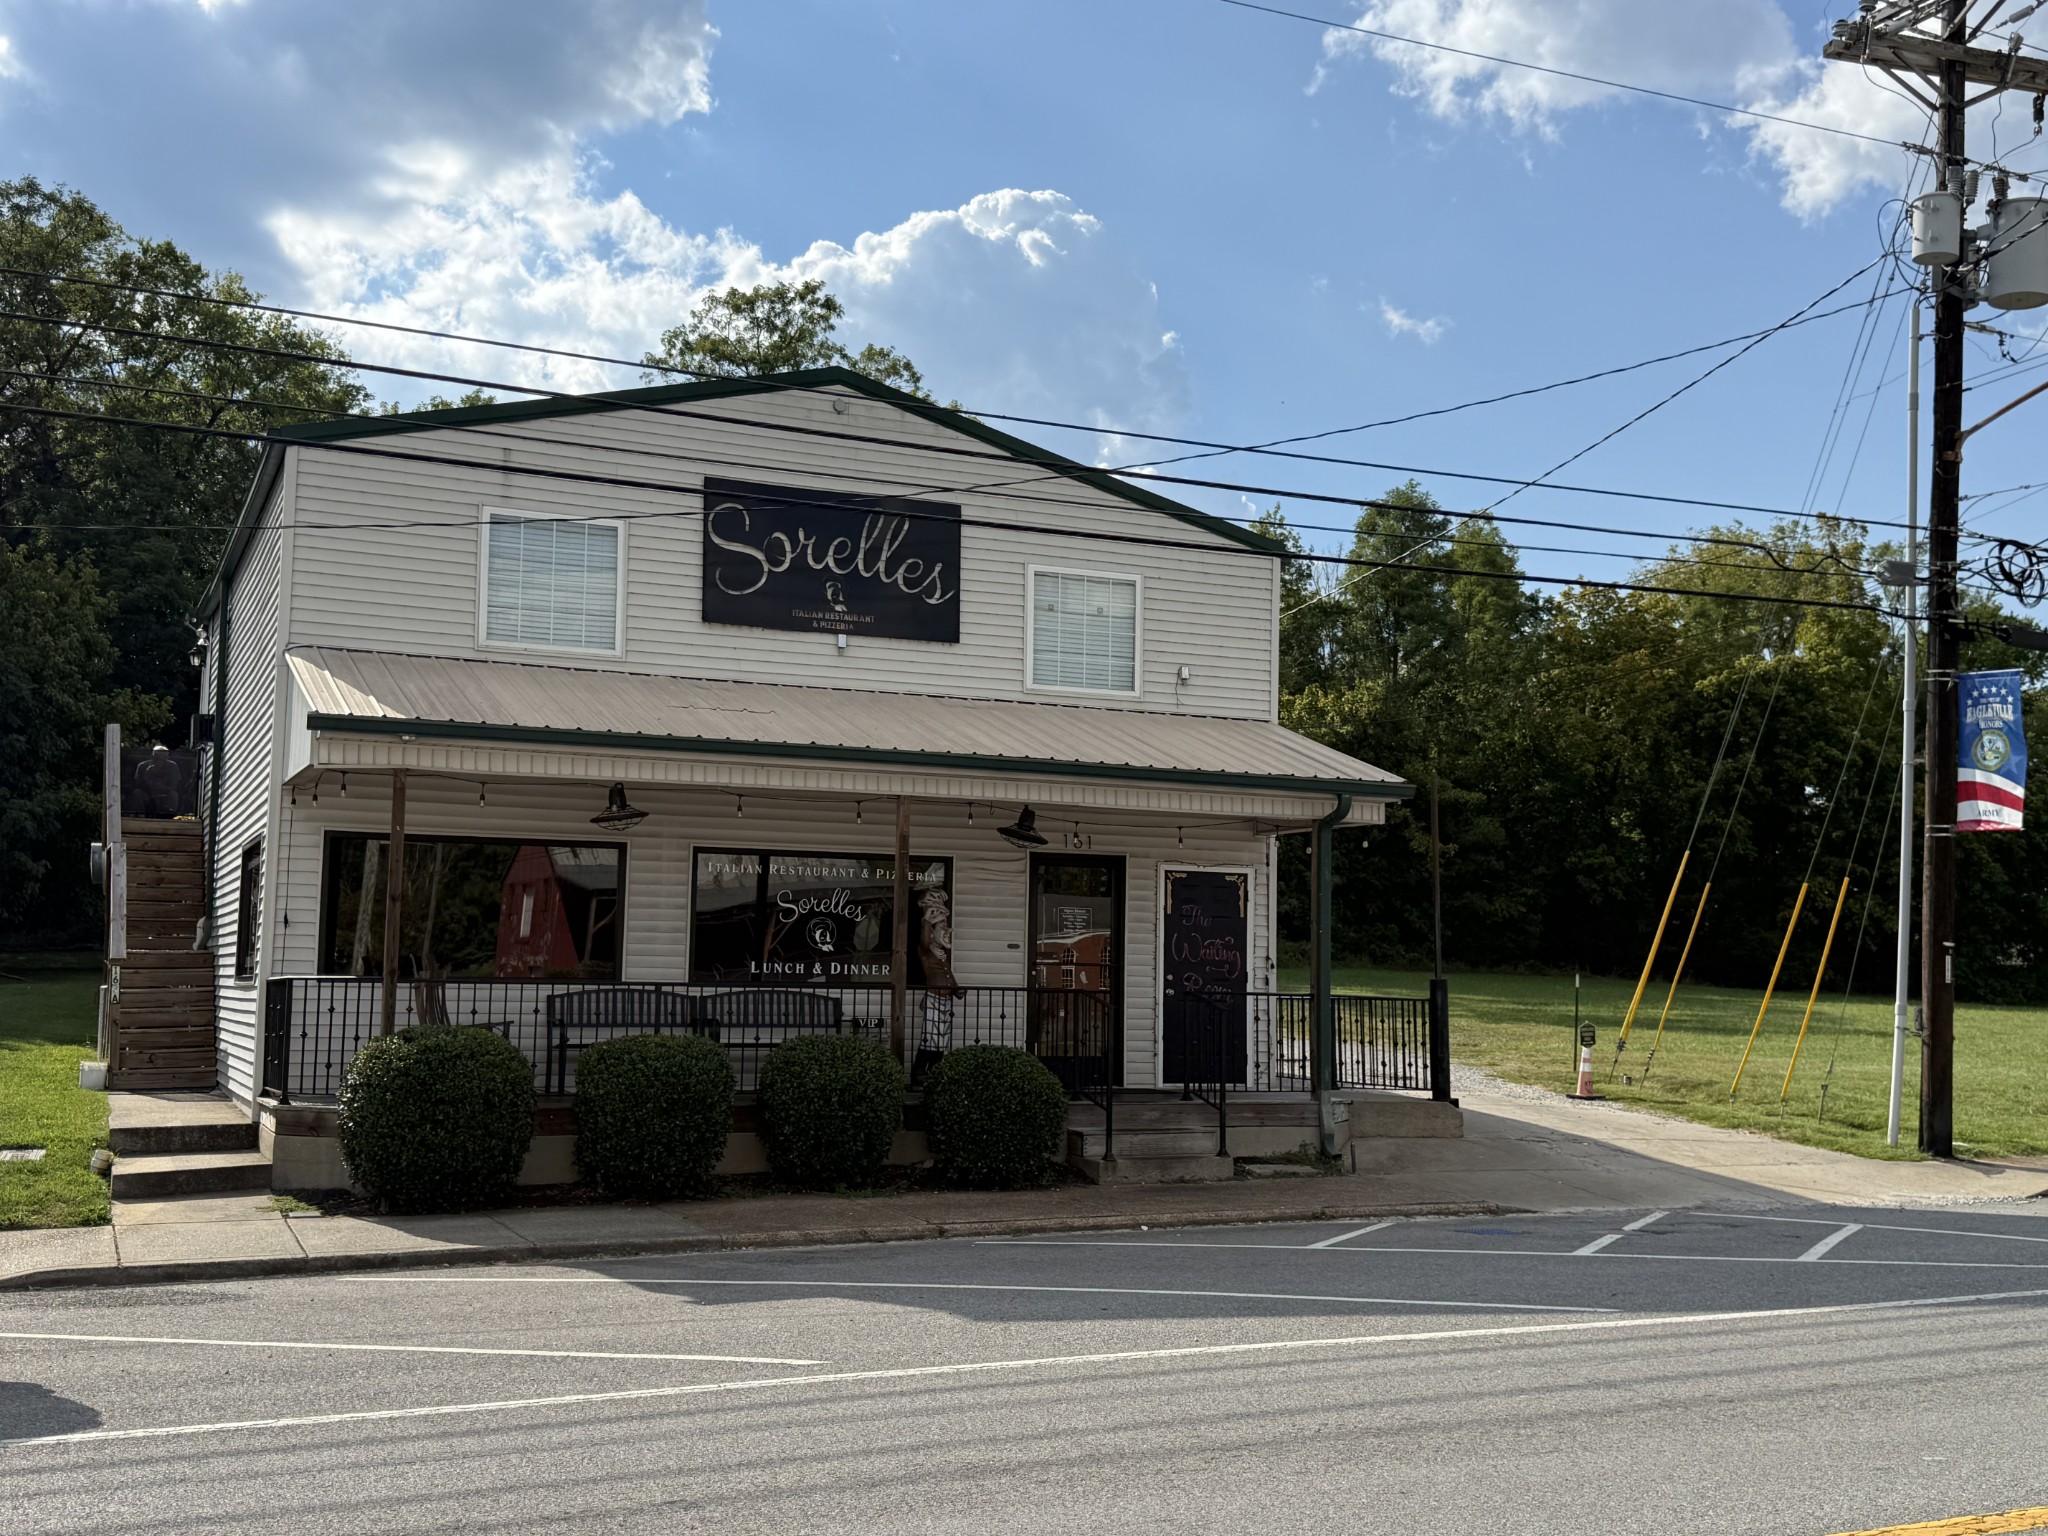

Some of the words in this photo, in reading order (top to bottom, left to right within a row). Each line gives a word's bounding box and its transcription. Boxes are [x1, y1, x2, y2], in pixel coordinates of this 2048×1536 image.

[708, 503, 956, 605] Sorelles
[792, 609, 824, 619] ITALIAN
[825, 612, 875, 623] RESTAURANT
[812, 619, 818, 628] &
[820, 620, 855, 630] PIZZERIA
[708, 861, 763, 875] ITALIAN
[770, 864, 855, 878] RESTAURANT
[861, 868, 870, 879] &
[776, 887, 867, 923] Sorelles
[1172, 932, 1241, 979] Waiting
[750, 960, 805, 974] LUNCH
[812, 962, 823, 975] &
[830, 962, 891, 976] DINNER
[858, 1018, 879, 1028] VIP
